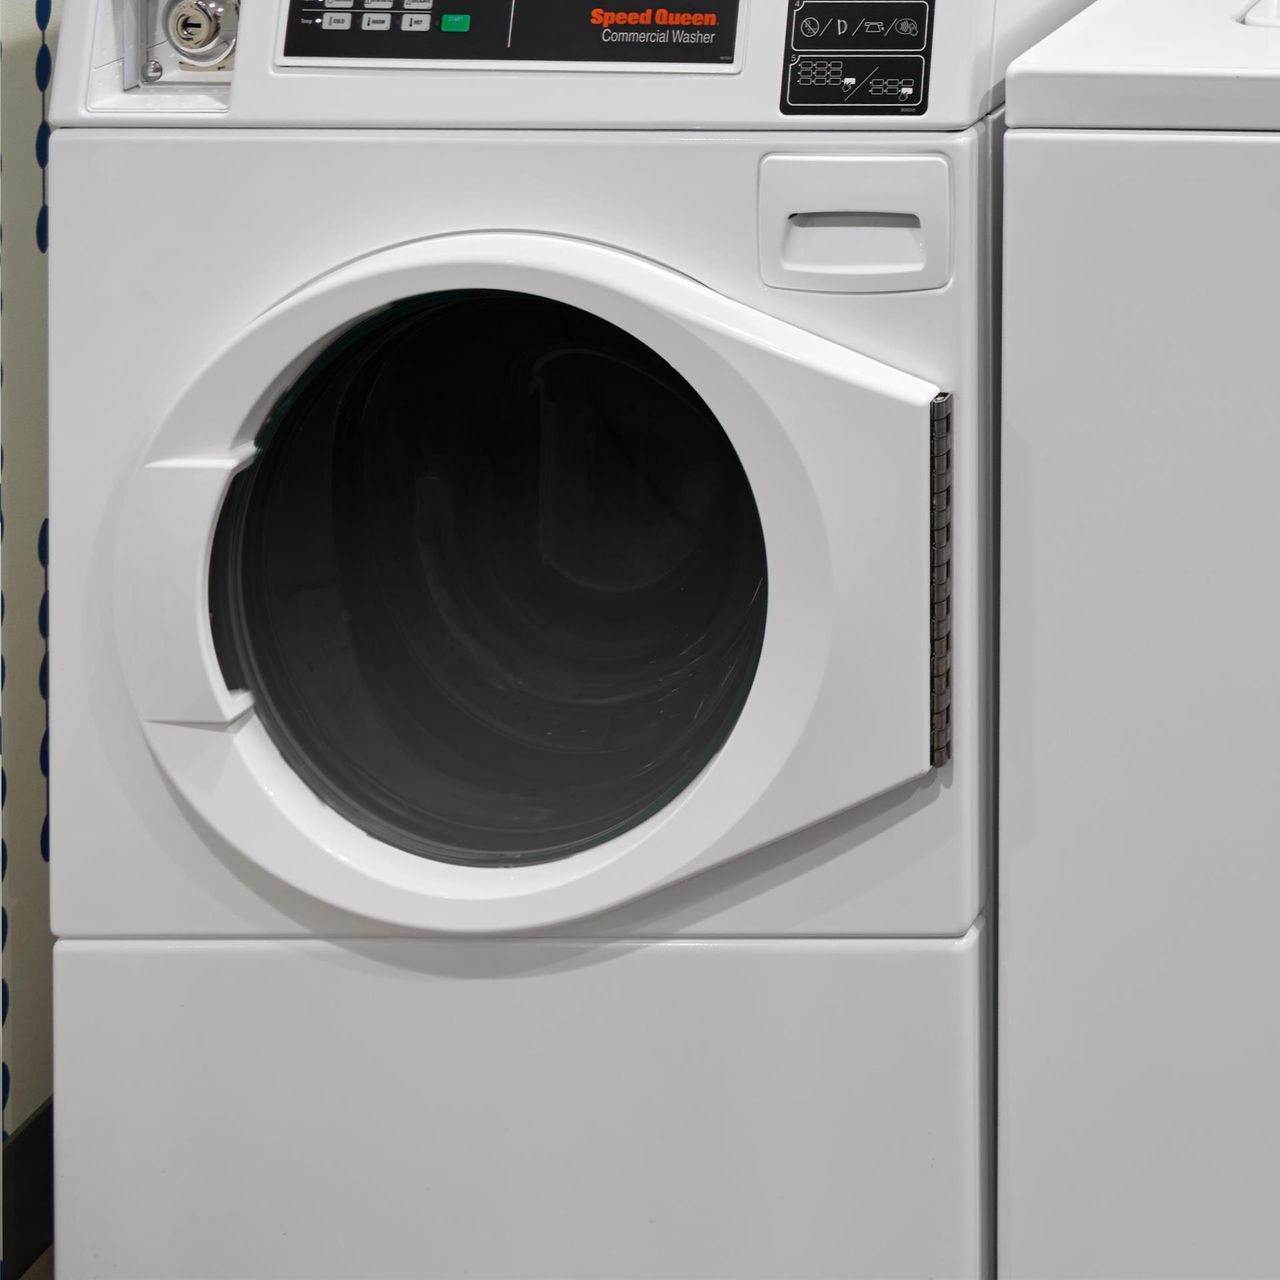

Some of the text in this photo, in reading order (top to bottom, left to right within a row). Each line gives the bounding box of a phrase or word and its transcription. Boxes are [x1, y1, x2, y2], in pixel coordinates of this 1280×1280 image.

[592, 8, 716, 27] Speed Queen
[601, 28, 716, 44] Commercial Washer
